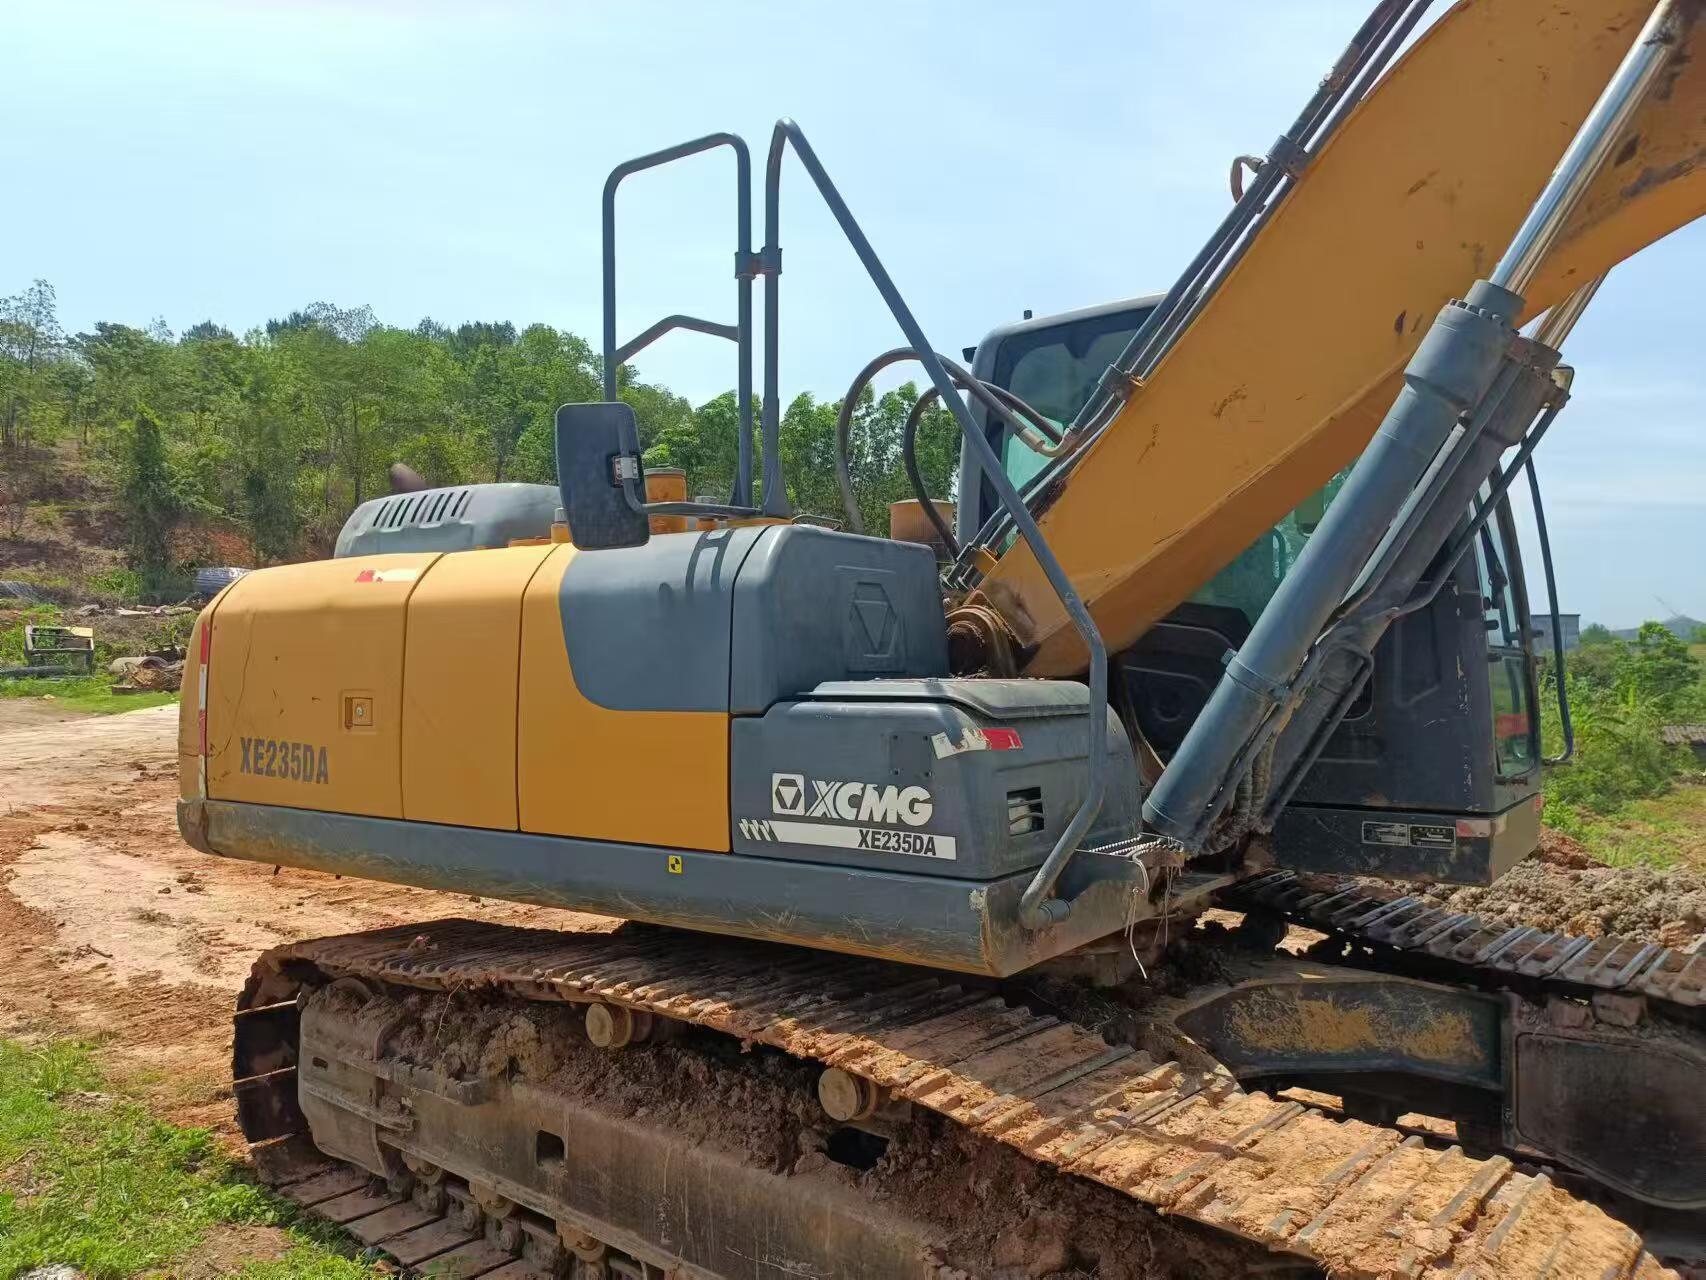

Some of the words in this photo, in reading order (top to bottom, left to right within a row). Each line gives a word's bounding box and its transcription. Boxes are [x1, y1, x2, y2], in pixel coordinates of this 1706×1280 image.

[240, 736, 329, 784] XE235DA
[805, 779, 933, 827] XCMG
[858, 829, 937, 856] XE235DA
